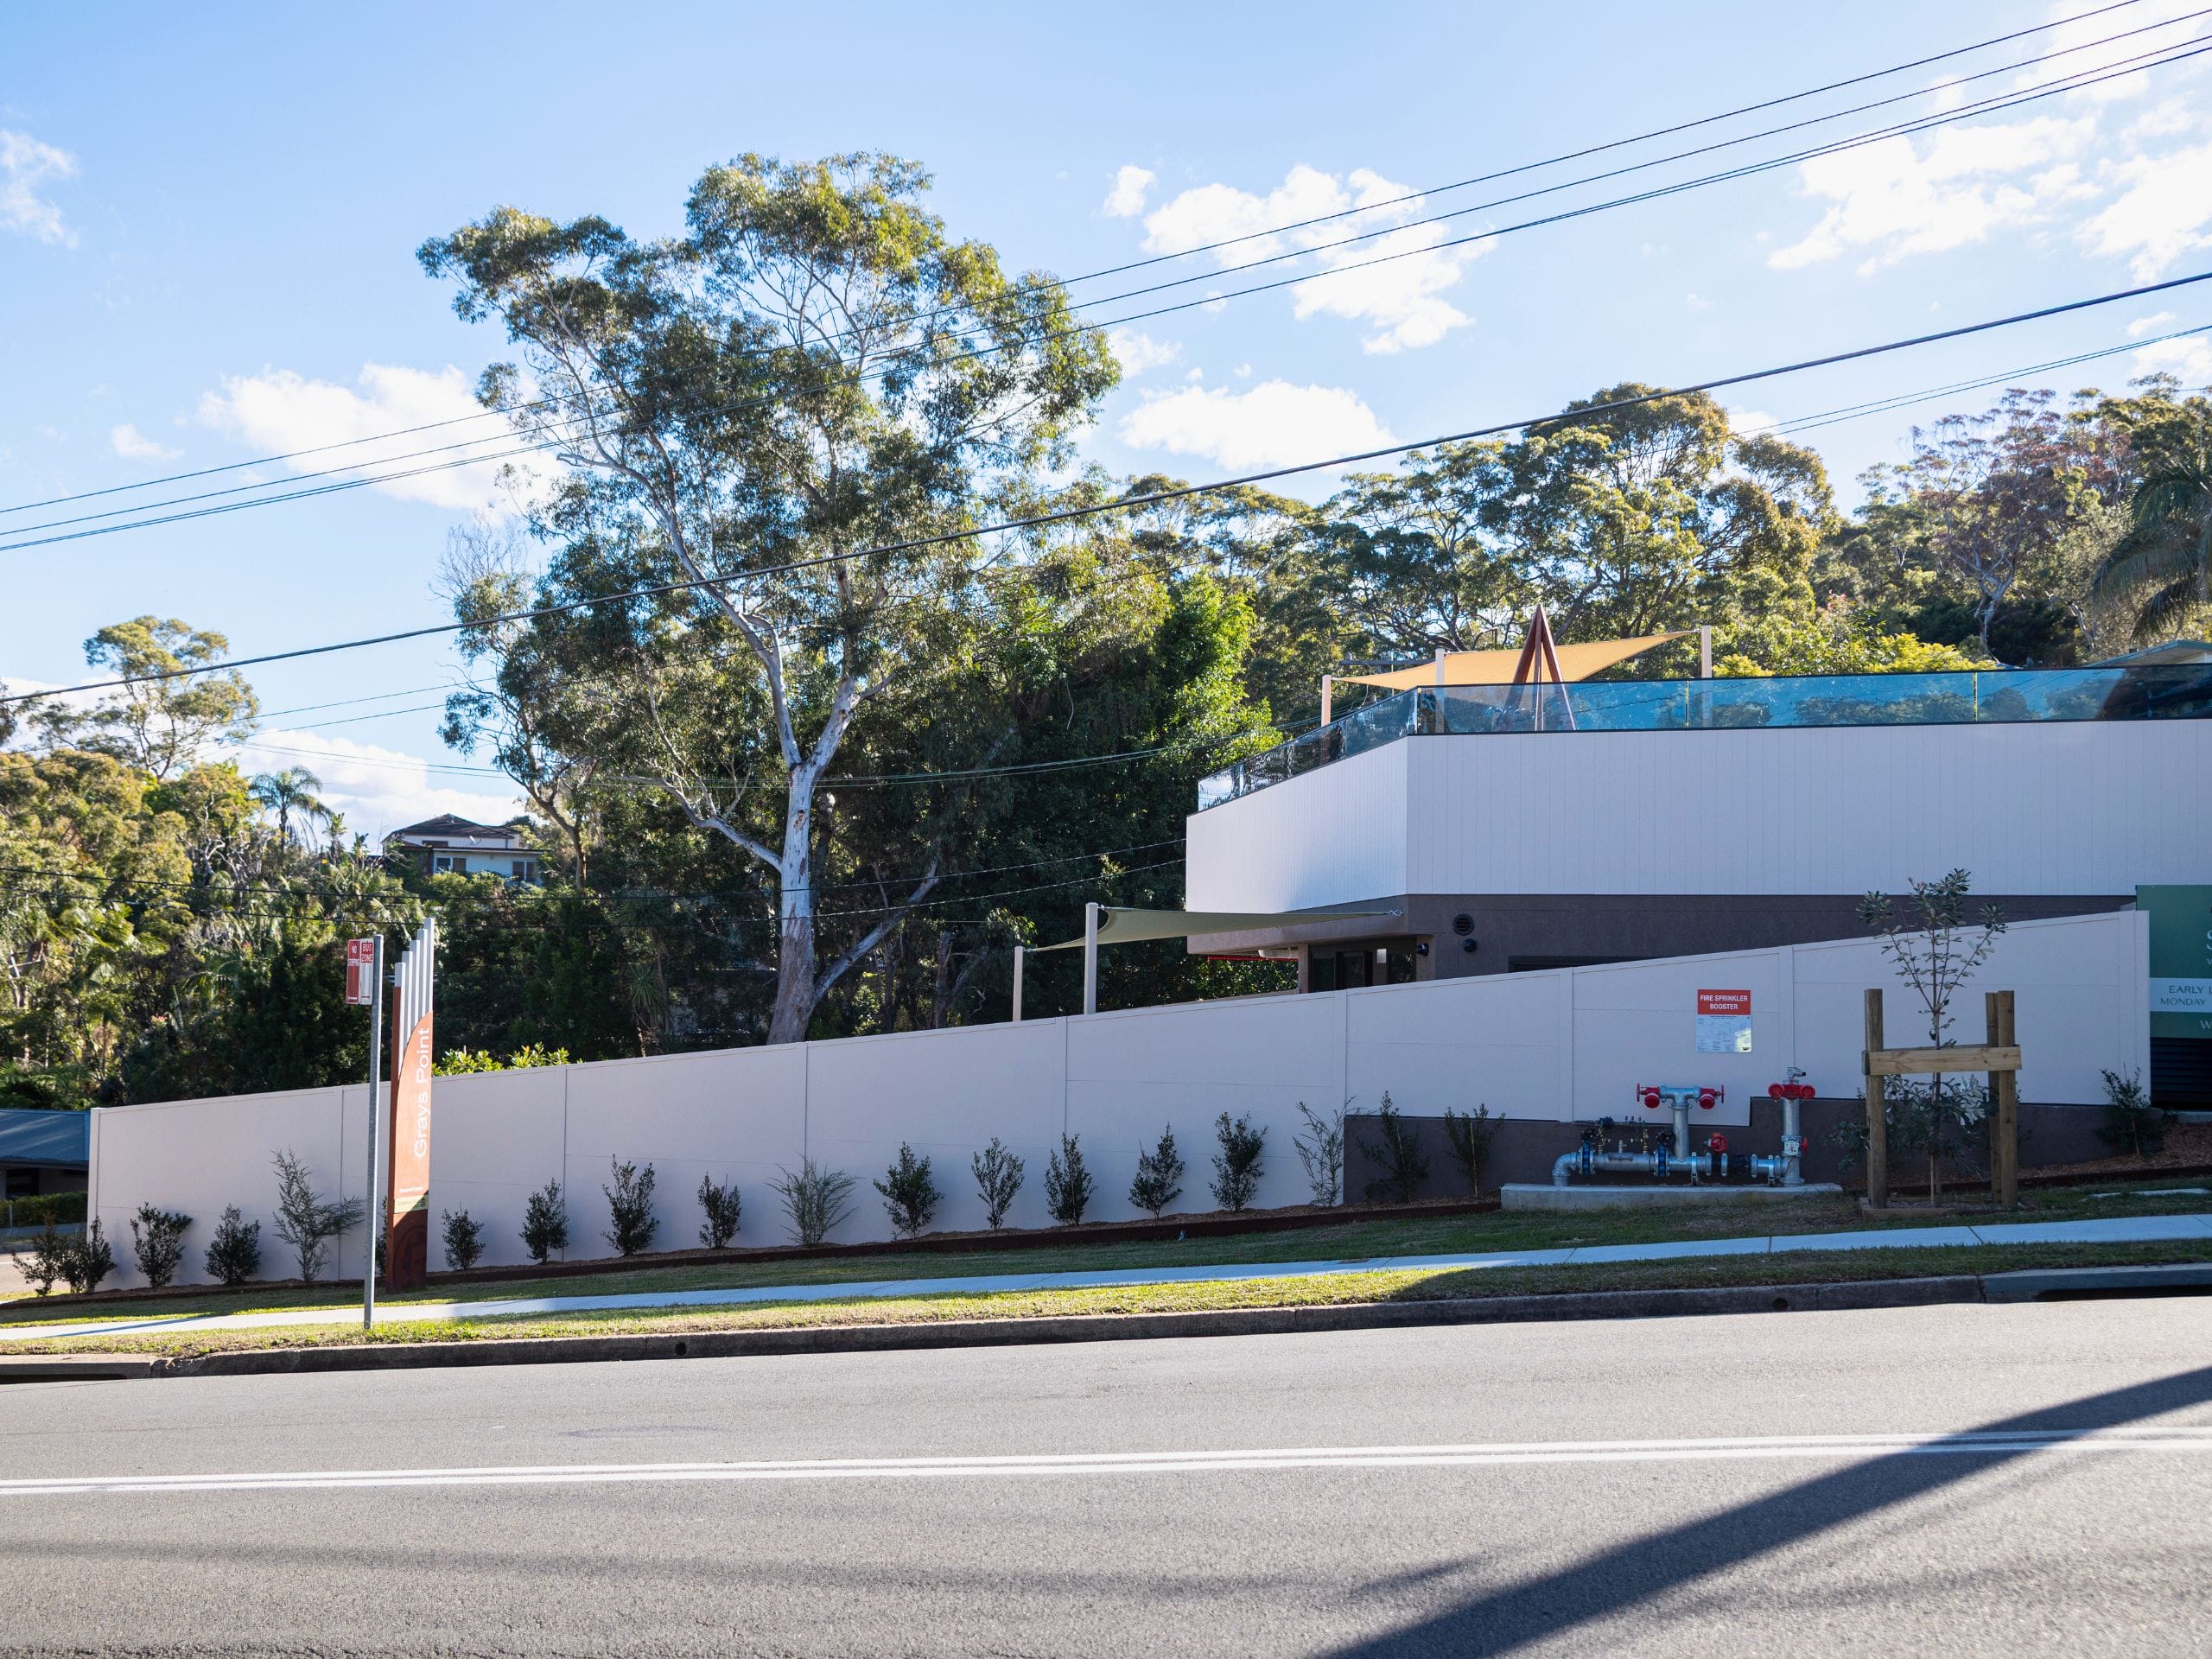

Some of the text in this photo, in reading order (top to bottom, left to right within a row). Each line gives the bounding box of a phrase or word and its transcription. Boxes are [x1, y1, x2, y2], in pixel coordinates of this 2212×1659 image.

[352, 945, 358, 954] NO
[362, 944, 372, 952] BUS
[2169, 985, 2204, 994] EARLY
[2160, 997, 2206, 1006] MONDAY
[414, 1027, 430, 1158] Grays Point
